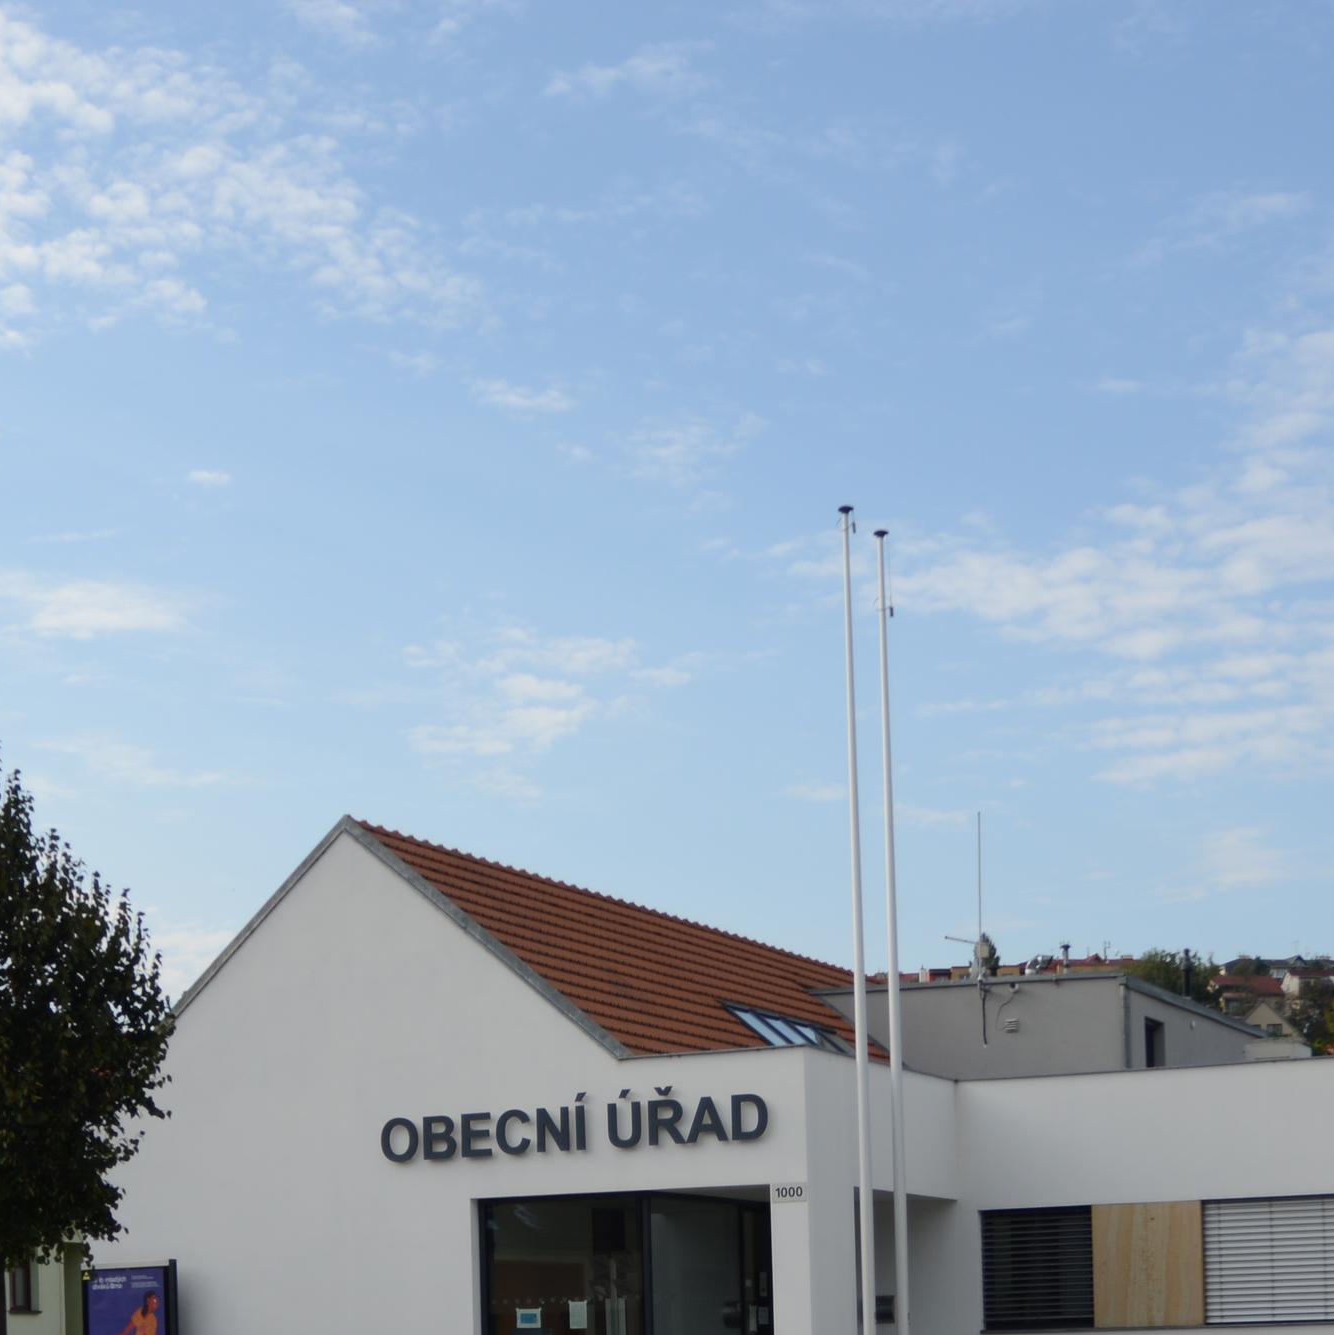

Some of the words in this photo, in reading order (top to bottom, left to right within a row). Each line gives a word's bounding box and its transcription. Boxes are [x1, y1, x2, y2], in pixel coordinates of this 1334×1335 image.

[380, 1092, 588, 1163] OBECNÍ
[607, 1086, 769, 1149] ÚŘAD
[775, 1186, 803, 1198] 1000
